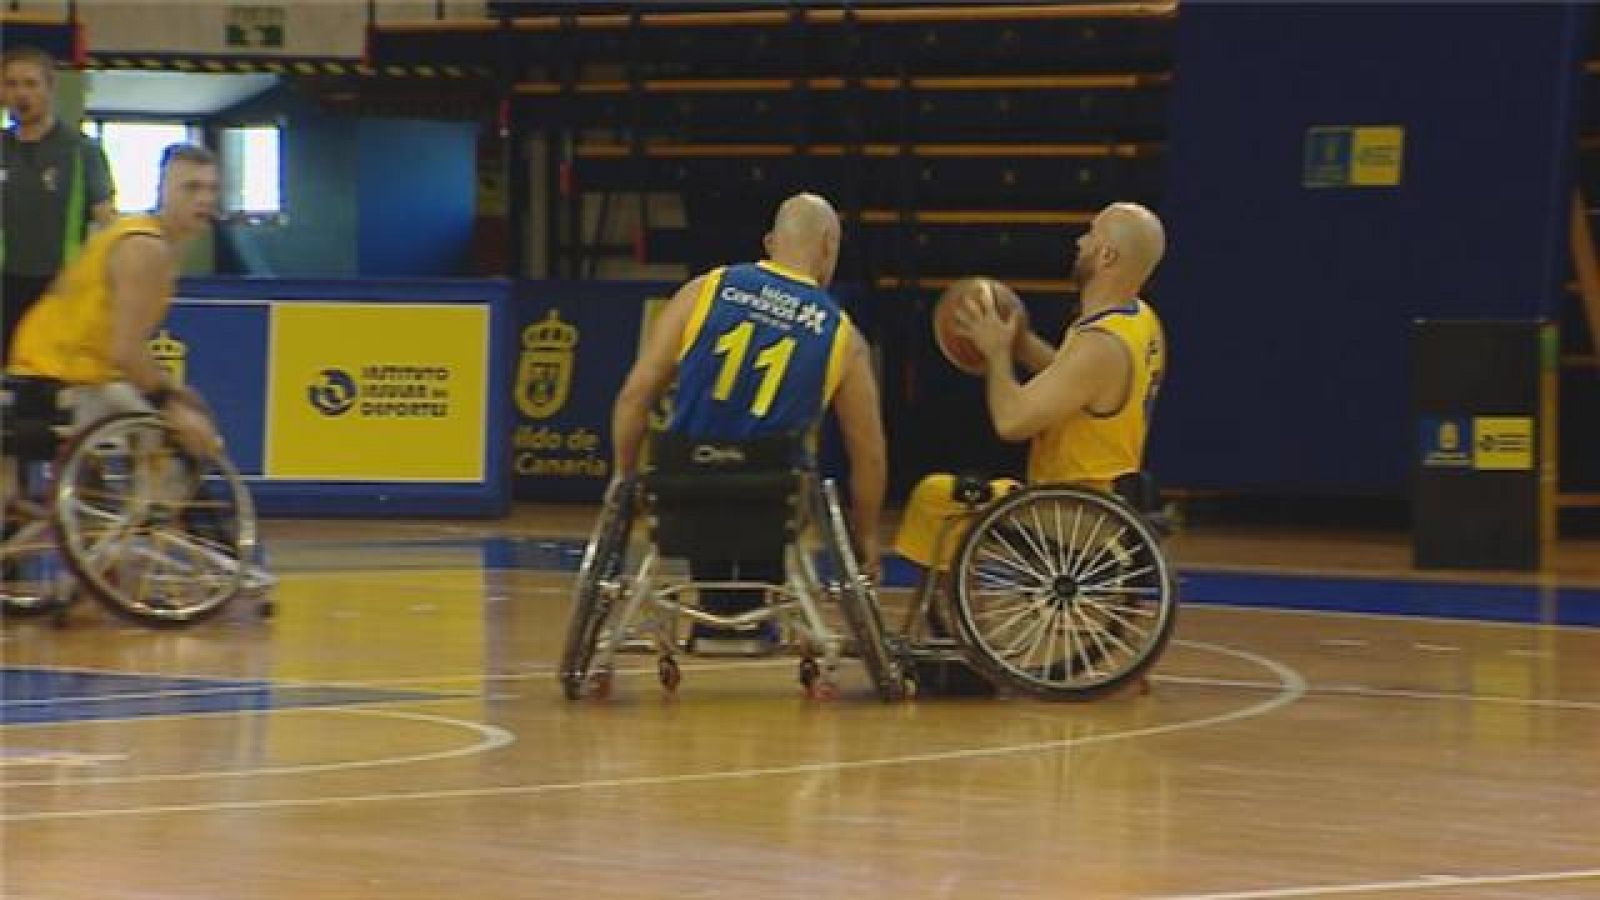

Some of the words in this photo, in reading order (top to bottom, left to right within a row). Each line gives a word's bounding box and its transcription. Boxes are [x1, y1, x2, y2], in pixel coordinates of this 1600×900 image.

[713, 321, 798, 417] 11
[567, 427, 601, 449] de
[512, 452, 608, 476] Canaria
